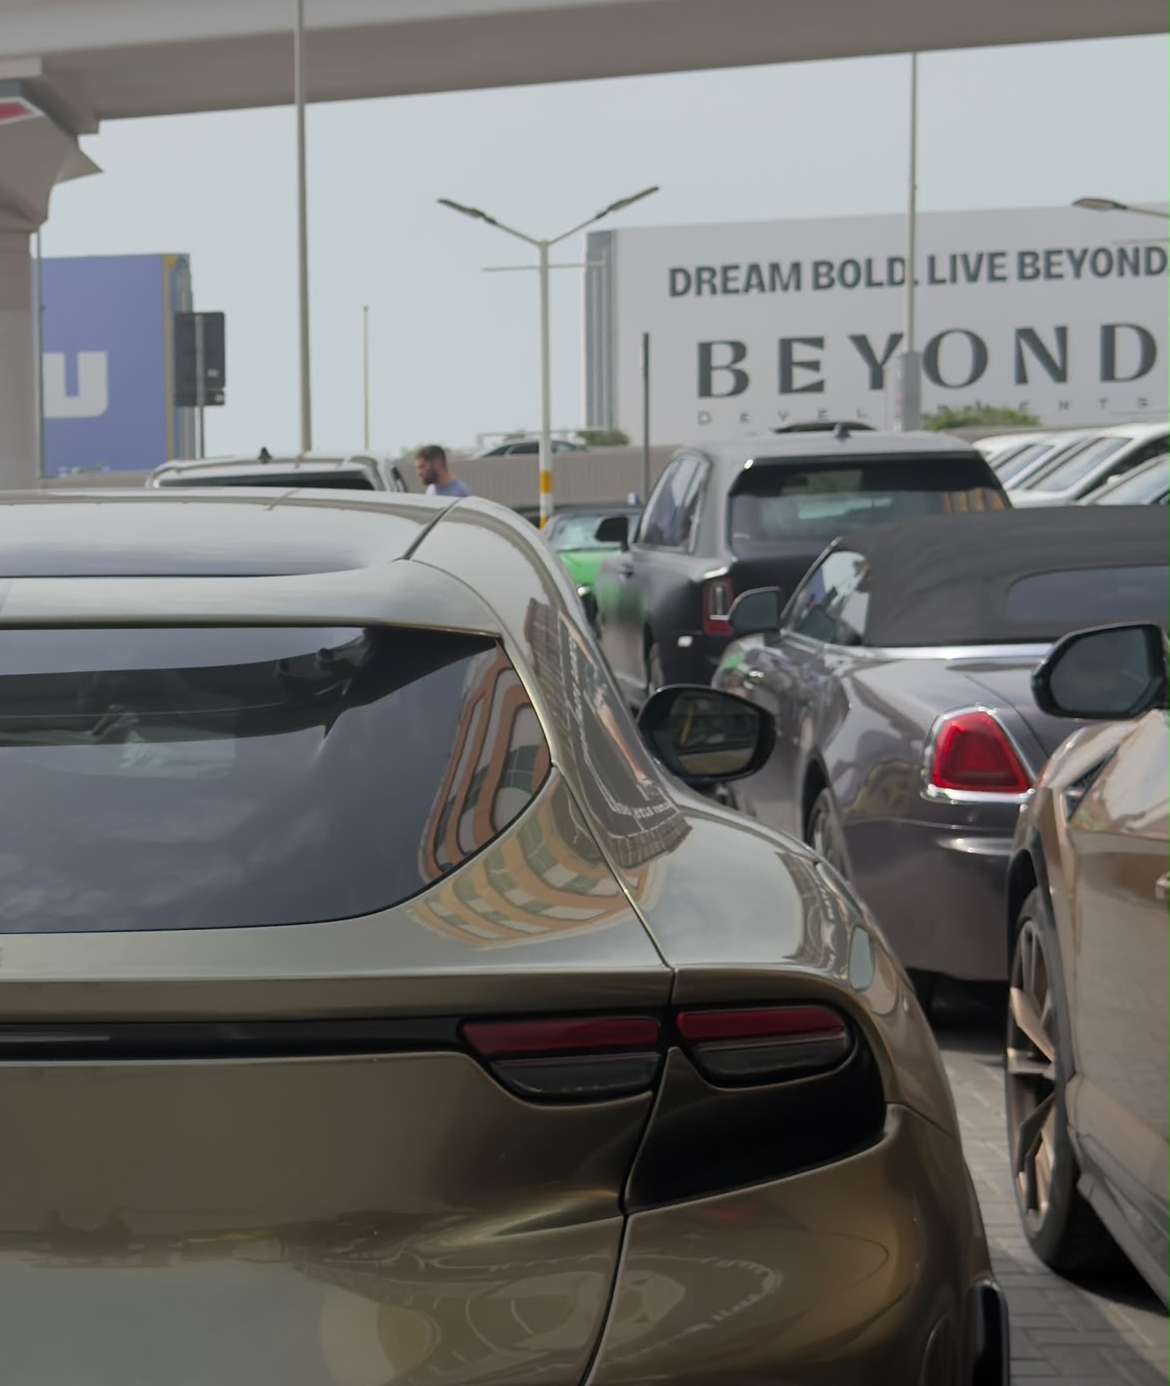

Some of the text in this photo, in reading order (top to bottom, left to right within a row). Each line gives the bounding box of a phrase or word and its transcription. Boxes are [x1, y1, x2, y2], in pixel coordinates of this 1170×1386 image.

[668, 244, 1168, 298] DREAM BOLD. LIVE BEYOND
[697, 322, 1158, 399] BEYOND
